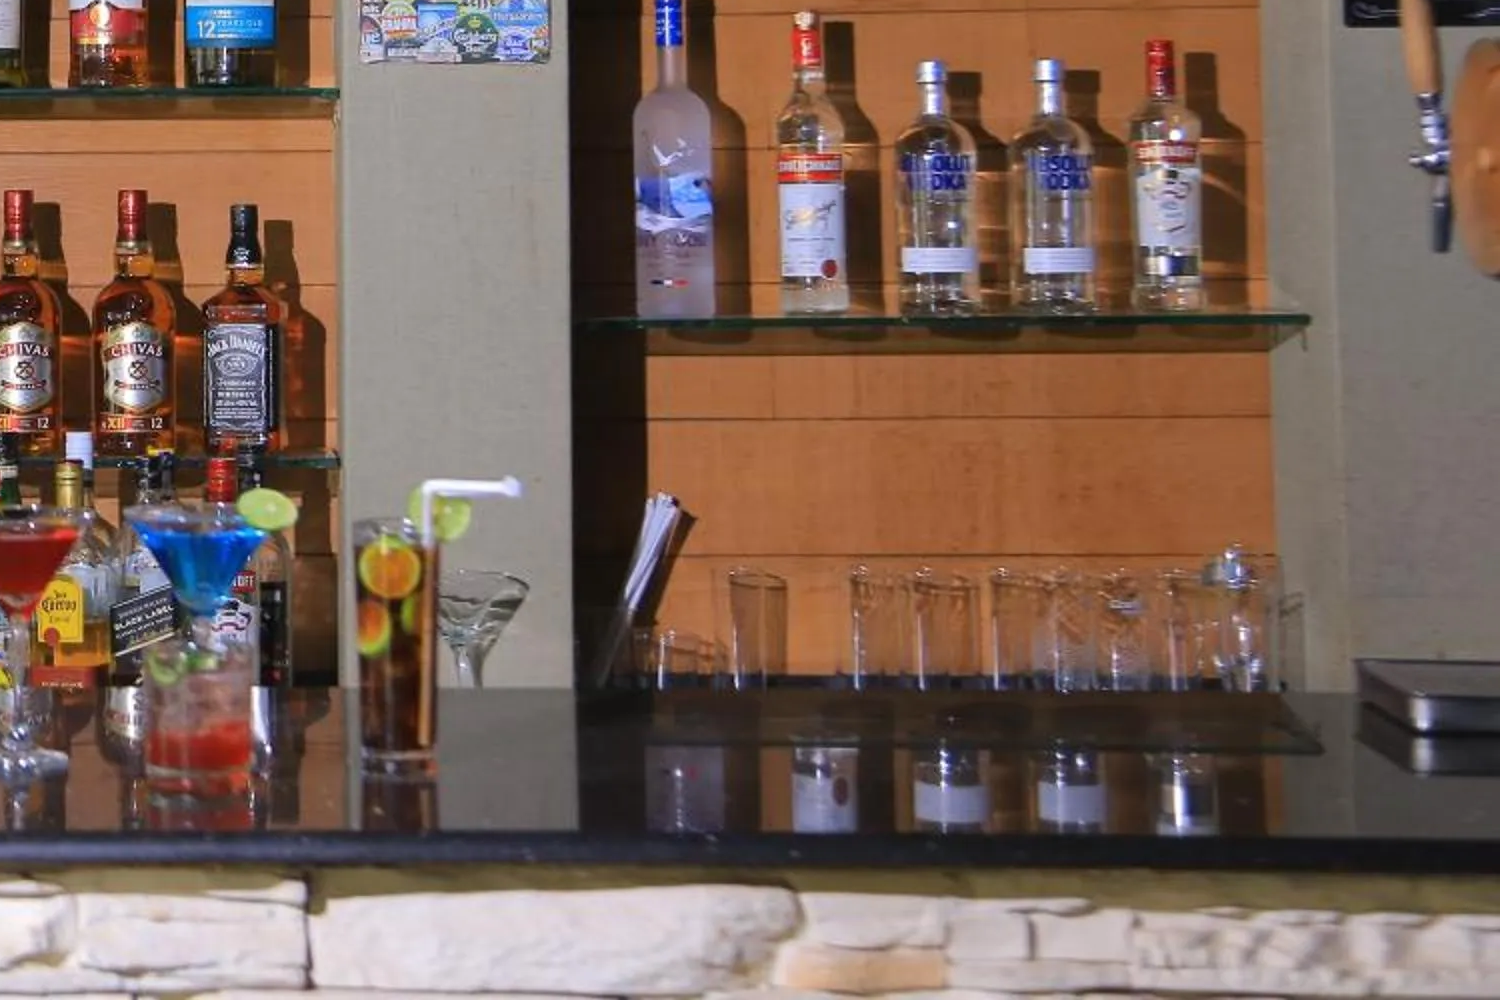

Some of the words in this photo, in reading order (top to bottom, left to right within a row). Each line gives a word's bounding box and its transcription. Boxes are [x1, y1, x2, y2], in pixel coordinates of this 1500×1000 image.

[197, 20, 216, 39] 12
[111, 343, 163, 358] CHIVAS
[37, 417, 50, 429] 12
[151, 417, 163, 429] 12
[114, 614, 143, 631] BLACK
[145, 605, 175, 620] LABEL
